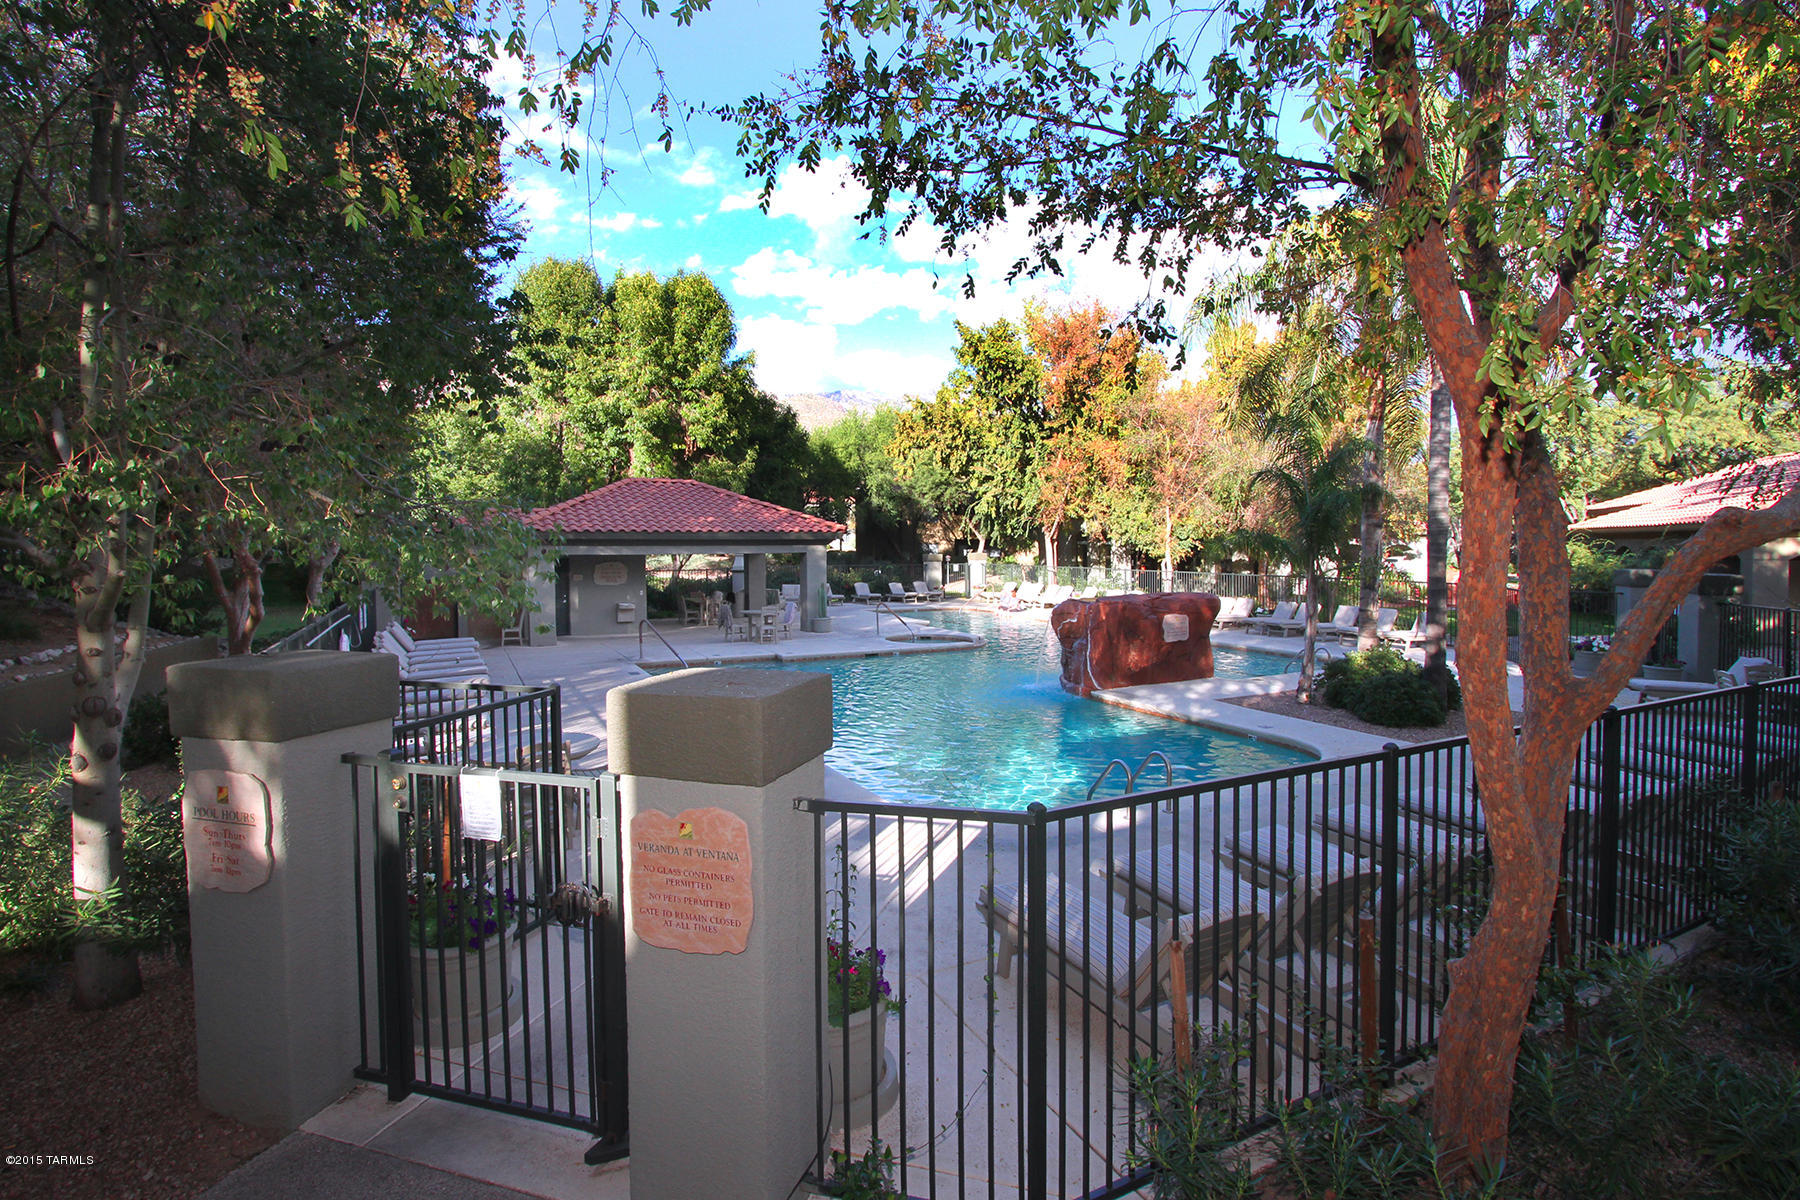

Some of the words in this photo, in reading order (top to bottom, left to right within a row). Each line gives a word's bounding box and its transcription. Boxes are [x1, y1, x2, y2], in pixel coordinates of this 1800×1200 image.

[193, 807, 218, 819] POOL
[222, 810, 255, 823] HOURS
[637, 841, 680, 856] VERANDA
[683, 847, 693, 857] AT
[696, 848, 740, 863] VENTANA
[643, 864, 656, 873] NO
[657, 867, 682, 877] GLASS
[683, 869, 735, 882] CONTAINERS
[665, 879, 713, 890] PERMITTED
[649, 892, 661, 900] NO
[663, 894, 682, 903] PETS
[684, 897, 731, 910] PERMITTED
[640, 907, 660, 917] GATE
[662, 910, 673, 918] TO
[675, 911, 708, 923] REMAIN
[710, 916, 742, 928] CLOSED
[663, 920, 673, 928] AT
[675, 921, 690, 930] ALL
[693, 923, 718, 934] TIMES
